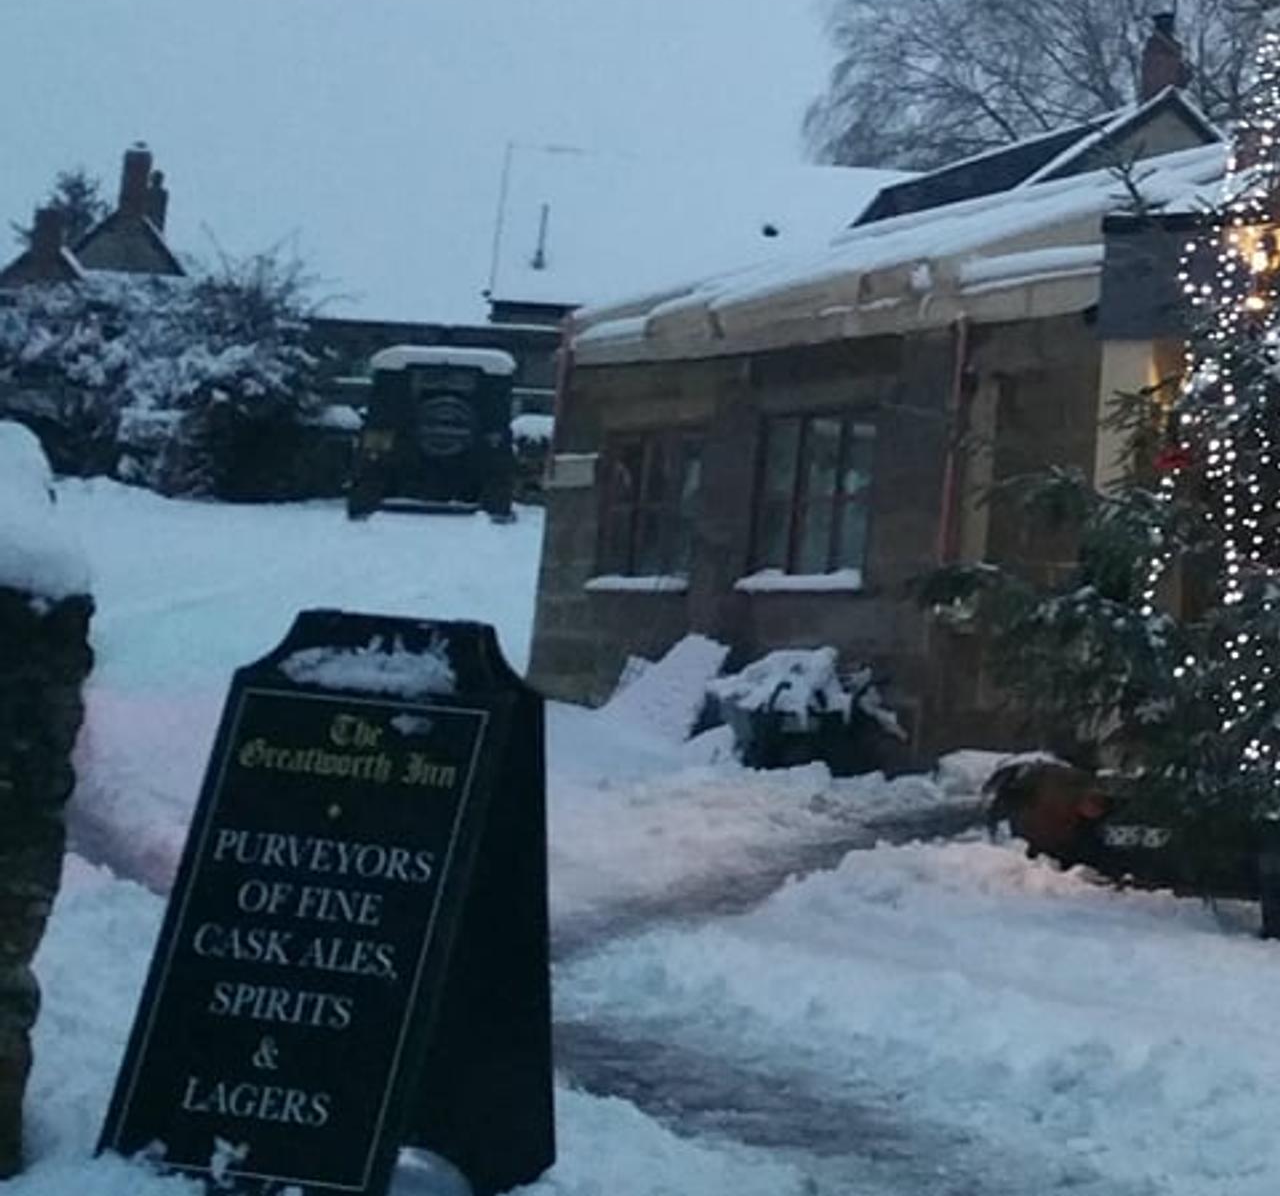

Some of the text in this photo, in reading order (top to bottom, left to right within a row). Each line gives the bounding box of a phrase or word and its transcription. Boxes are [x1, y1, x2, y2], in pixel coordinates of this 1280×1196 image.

[329, 713, 384, 750] The
[238, 737, 457, 789] Greatworth Inn
[213, 827, 436, 884] PURVEYORS
[236, 878, 383, 927] OF FINE
[192, 922, 293, 966] CASK
[208, 981, 354, 1030] SPIRITS
[251, 1034, 280, 1071] &
[181, 1075, 332, 1127] LAGERS
